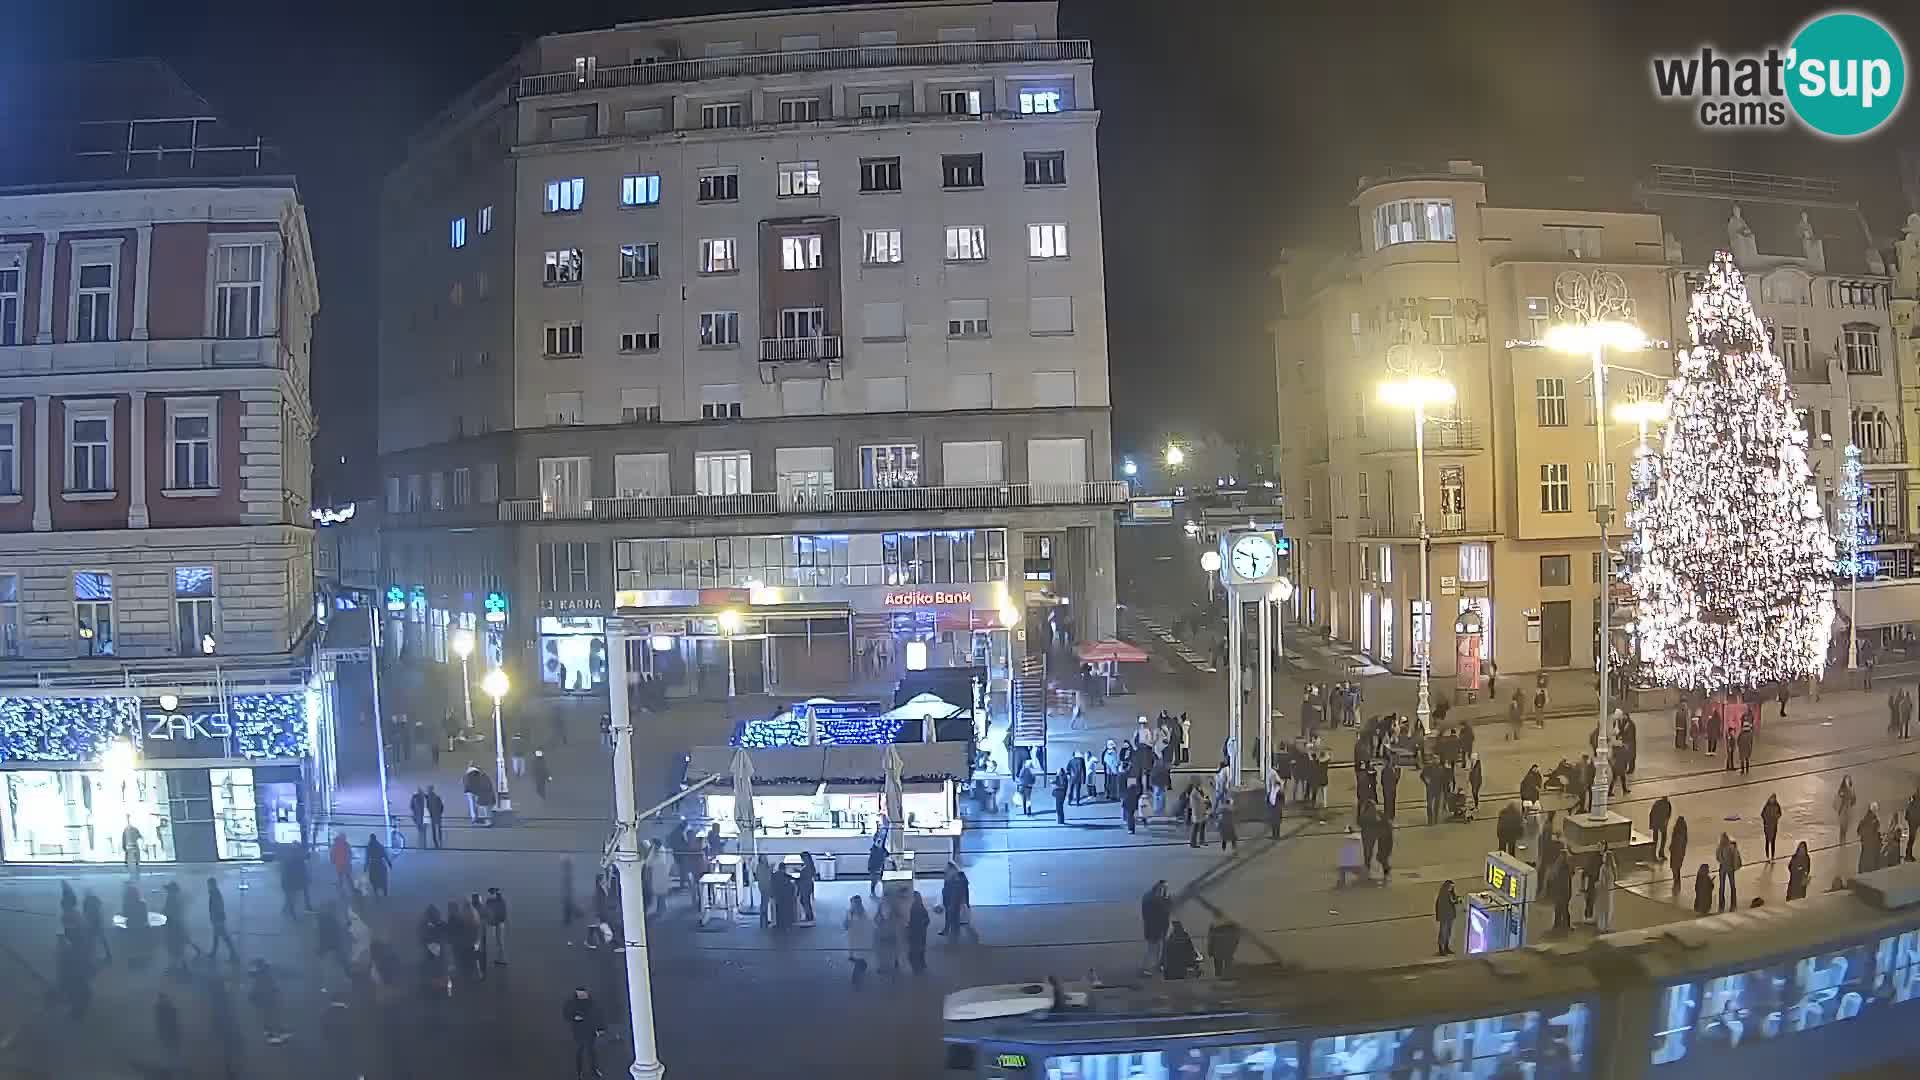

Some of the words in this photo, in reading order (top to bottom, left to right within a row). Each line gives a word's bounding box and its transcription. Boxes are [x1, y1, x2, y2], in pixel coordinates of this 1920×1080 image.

[884, 592, 934, 605] Addiko
[935, 591, 972, 604] Bank
[147, 714, 232, 741] ZAKS
